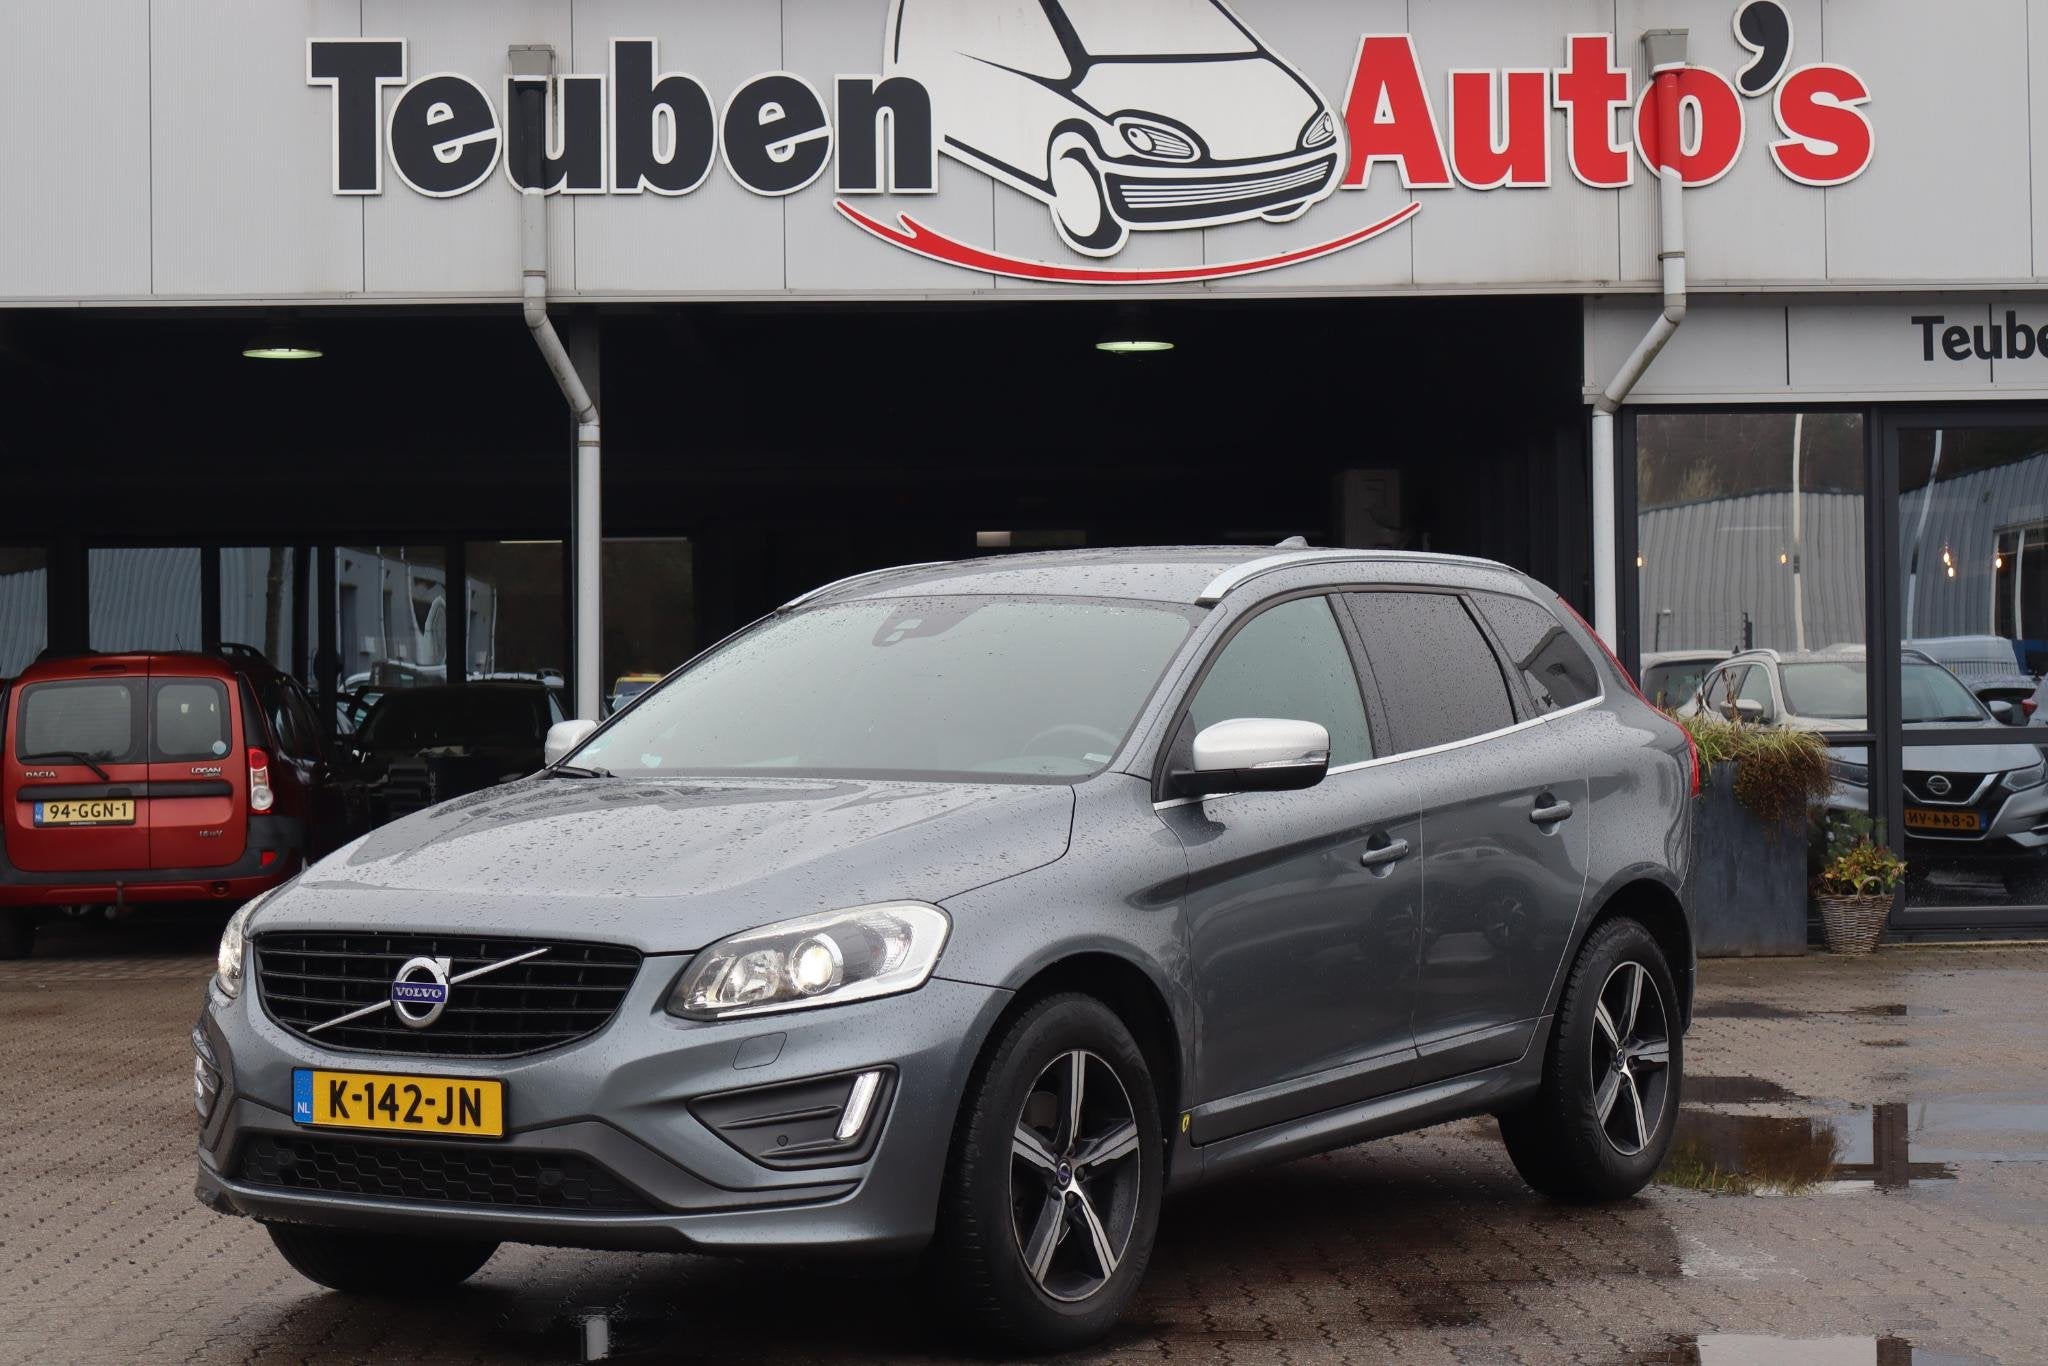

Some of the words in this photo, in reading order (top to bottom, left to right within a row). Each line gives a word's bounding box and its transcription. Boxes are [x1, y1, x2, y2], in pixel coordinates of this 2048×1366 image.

[309, 39, 935, 196] Teuben
[25, 770, 56, 778] DACIA
[191, 766, 222, 774] LOGAN
[49, 802, 127, 820] 94-GGN-1
[395, 985, 443, 999] VOLVO
[297, 1101, 311, 1115] NL
[328, 1079, 482, 1128] K-142-JN
